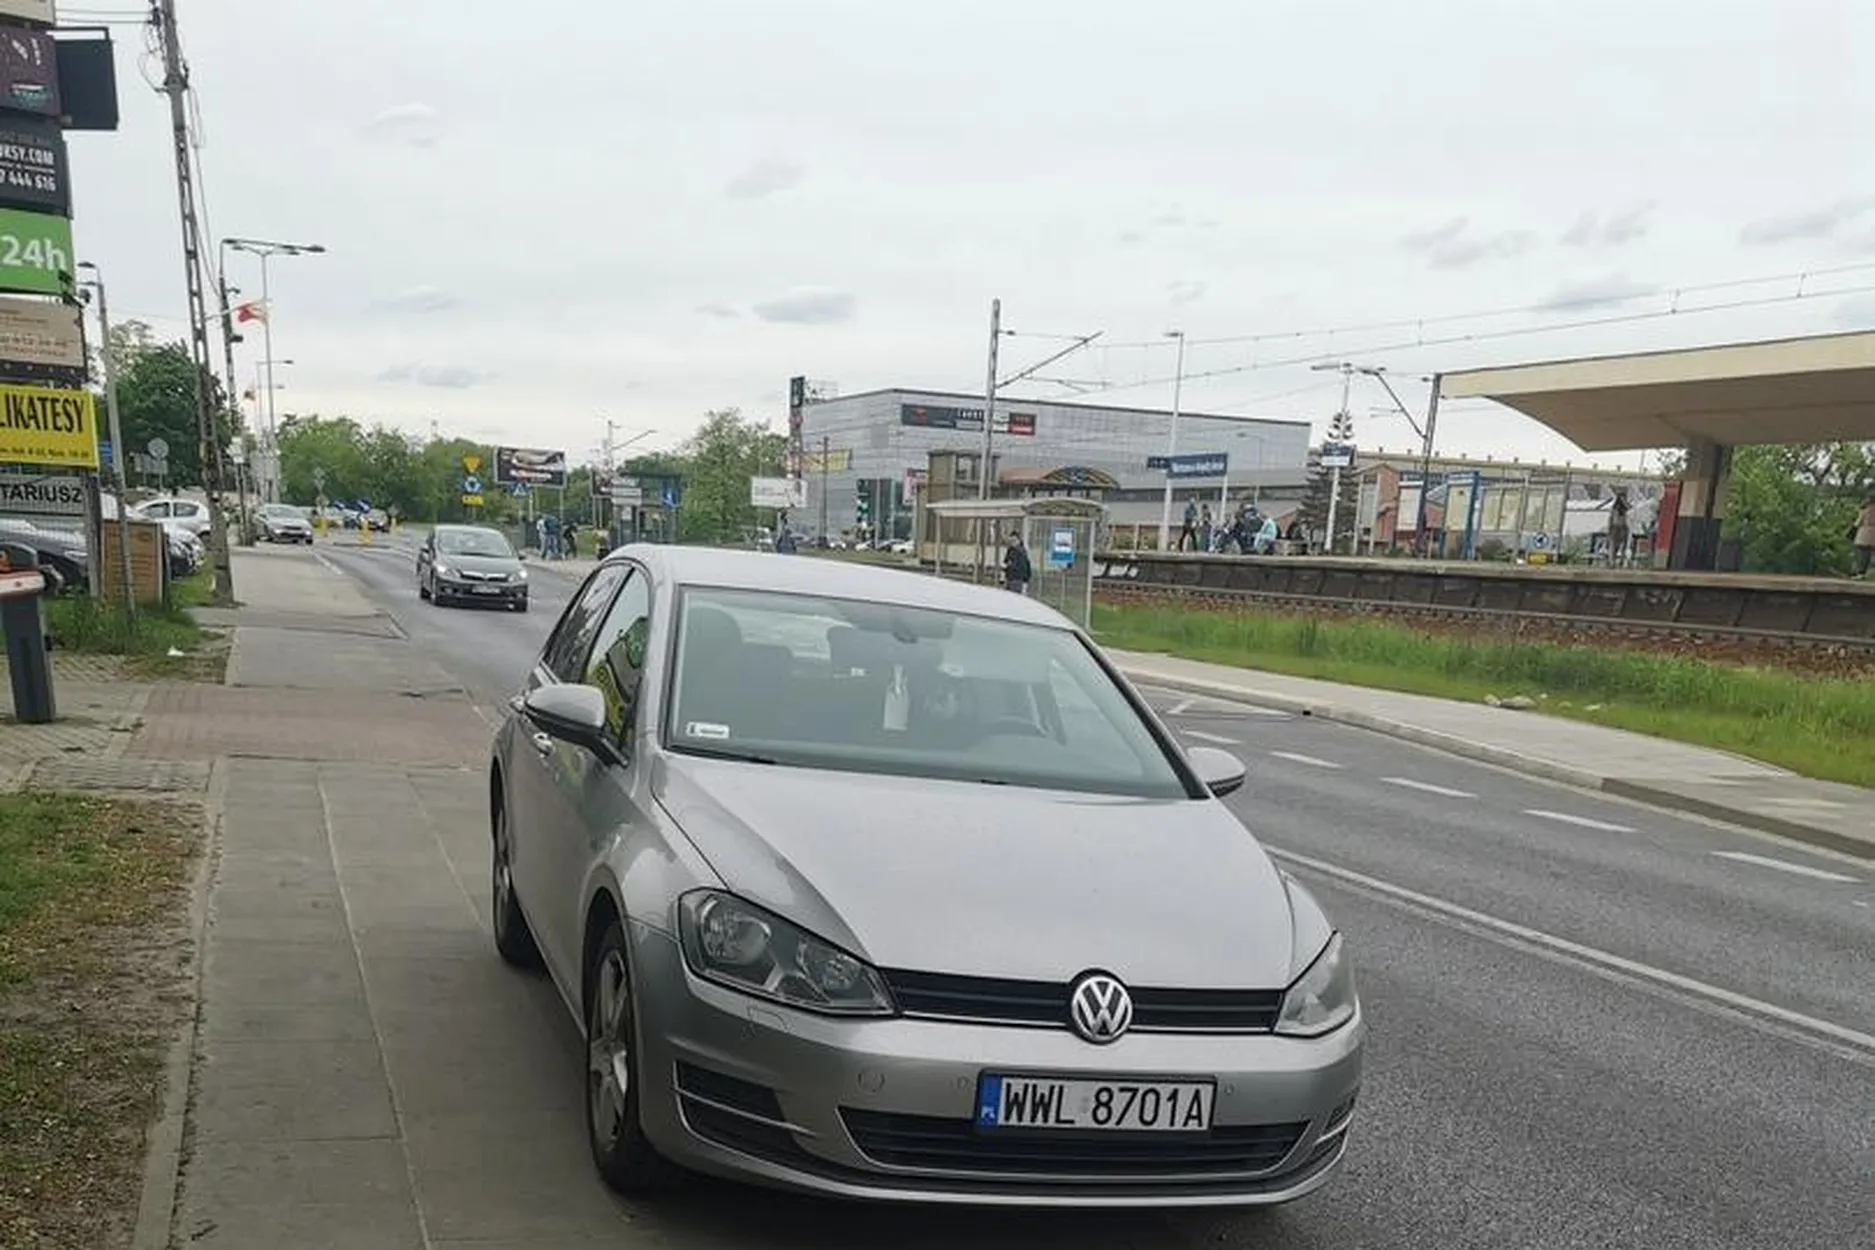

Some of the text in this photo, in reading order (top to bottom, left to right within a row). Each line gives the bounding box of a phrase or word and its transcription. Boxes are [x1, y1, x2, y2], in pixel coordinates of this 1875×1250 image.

[0, 235, 67, 271] 24h
[1003, 1081, 1075, 1124] WWL
[1092, 1086, 1203, 1127] 8701A
